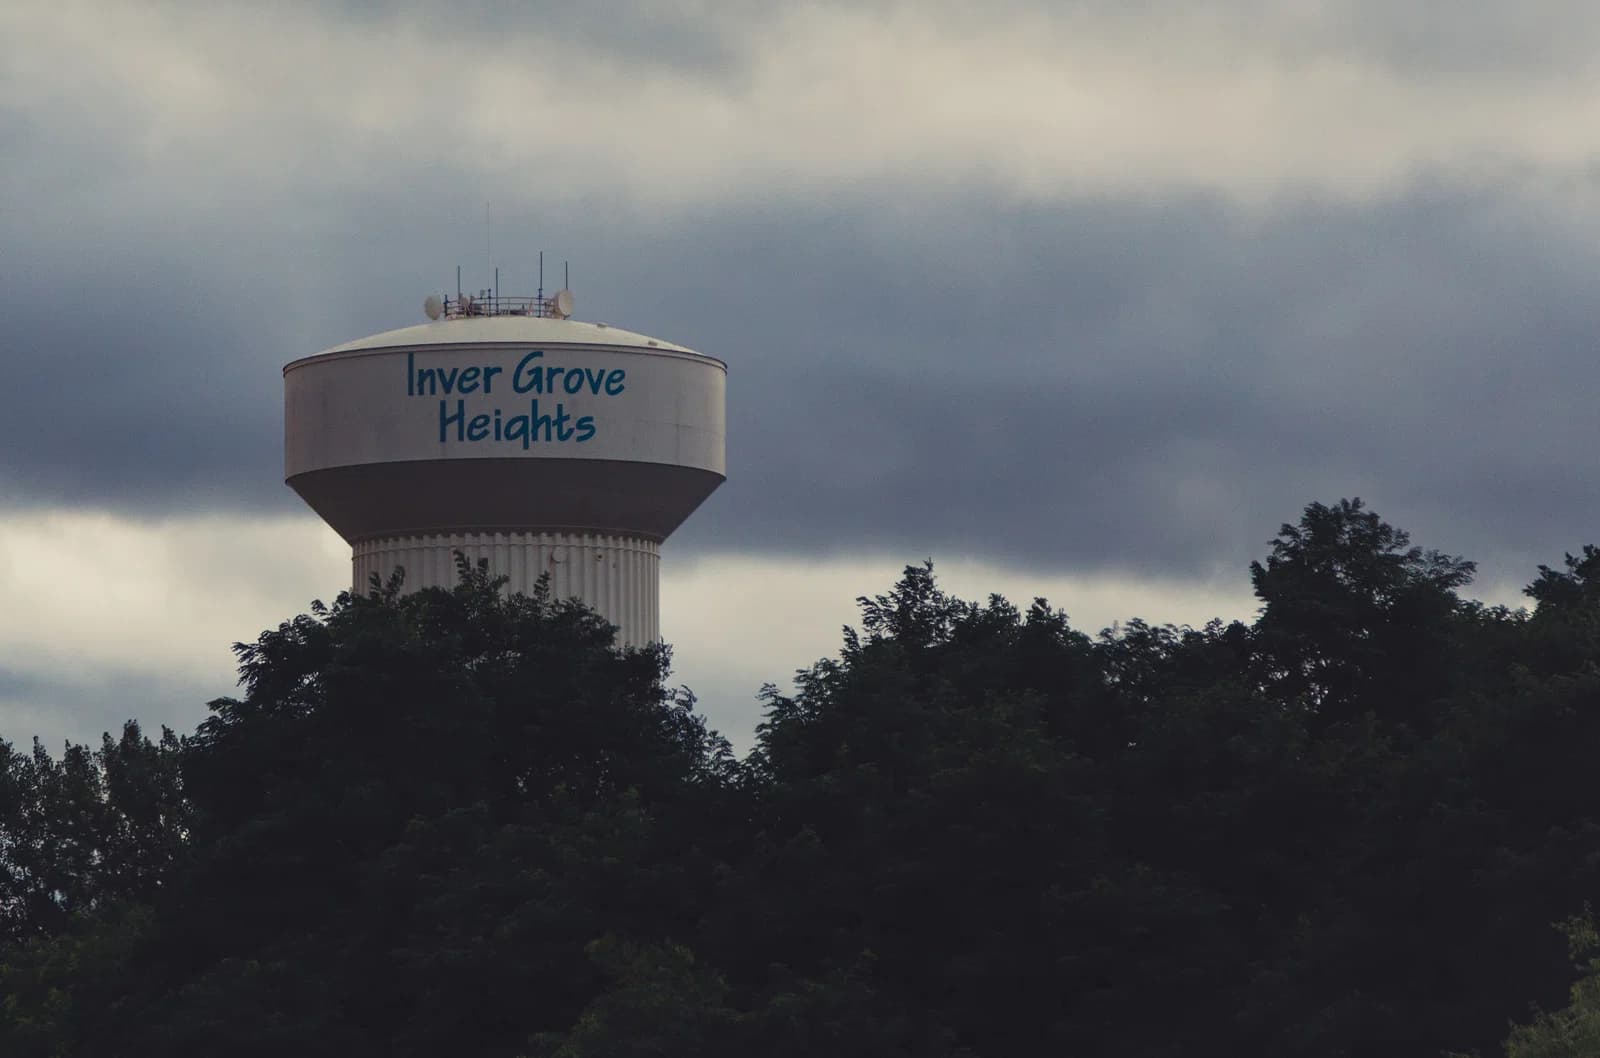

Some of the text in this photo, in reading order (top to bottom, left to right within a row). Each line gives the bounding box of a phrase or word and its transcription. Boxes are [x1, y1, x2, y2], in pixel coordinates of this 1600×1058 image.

[408, 351, 626, 396] Inver Grove
[439, 399, 598, 450] Heights
